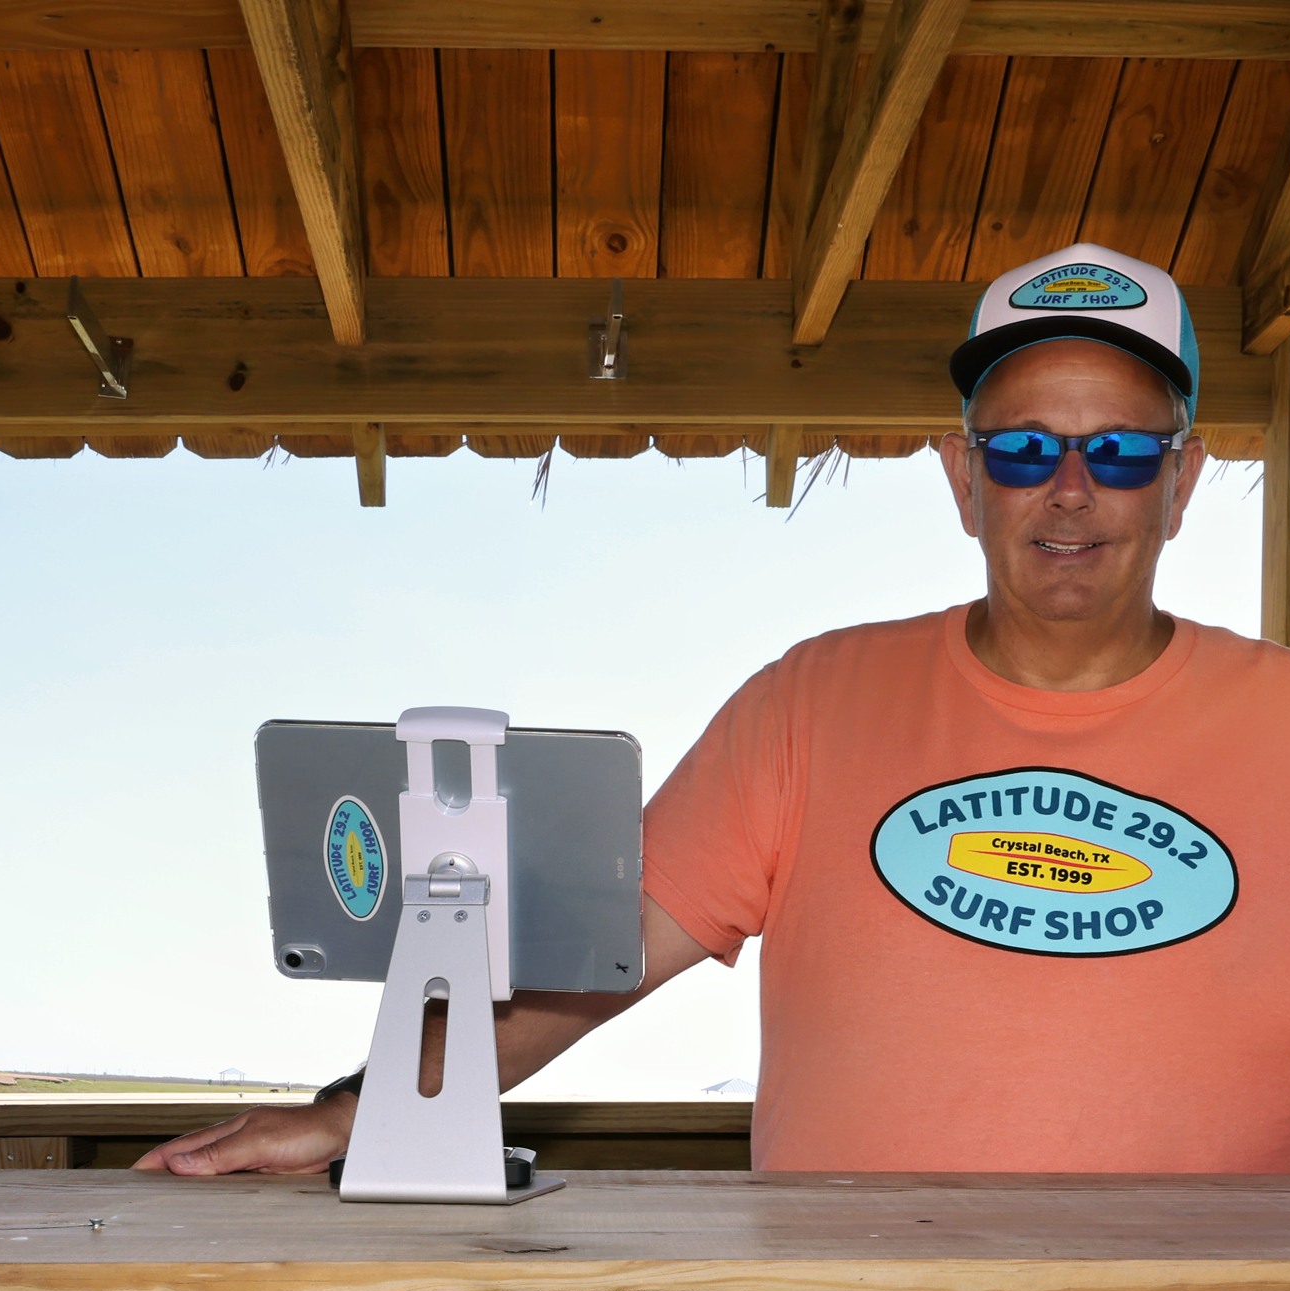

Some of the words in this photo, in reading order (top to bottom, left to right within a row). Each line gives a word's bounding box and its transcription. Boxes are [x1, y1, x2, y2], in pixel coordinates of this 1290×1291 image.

[1032, 267, 1098, 289] LATITUDE
[1104, 273, 1131, 292] 29.2
[1033, 294, 1072, 304] SURF
[1081, 294, 1119, 304] SHOP
[334, 811, 350, 837] 29.2
[359, 821, 377, 854] SHOP
[909, 786, 1118, 835] LATITUDE
[1123, 812, 1208, 869] 29.2
[992, 838, 1041, 852] Crystal
[1044, 844, 1089, 863] Beach,
[1093, 853, 1110, 864] TX
[331, 843, 357, 900] LATITUDE
[367, 862, 379, 896] SURF
[1006, 861, 1044, 879] EST.
[1049, 867, 1093, 885] 1999
[924, 875, 1035, 935] SURF
[1044, 899, 1164, 940] SHOP
